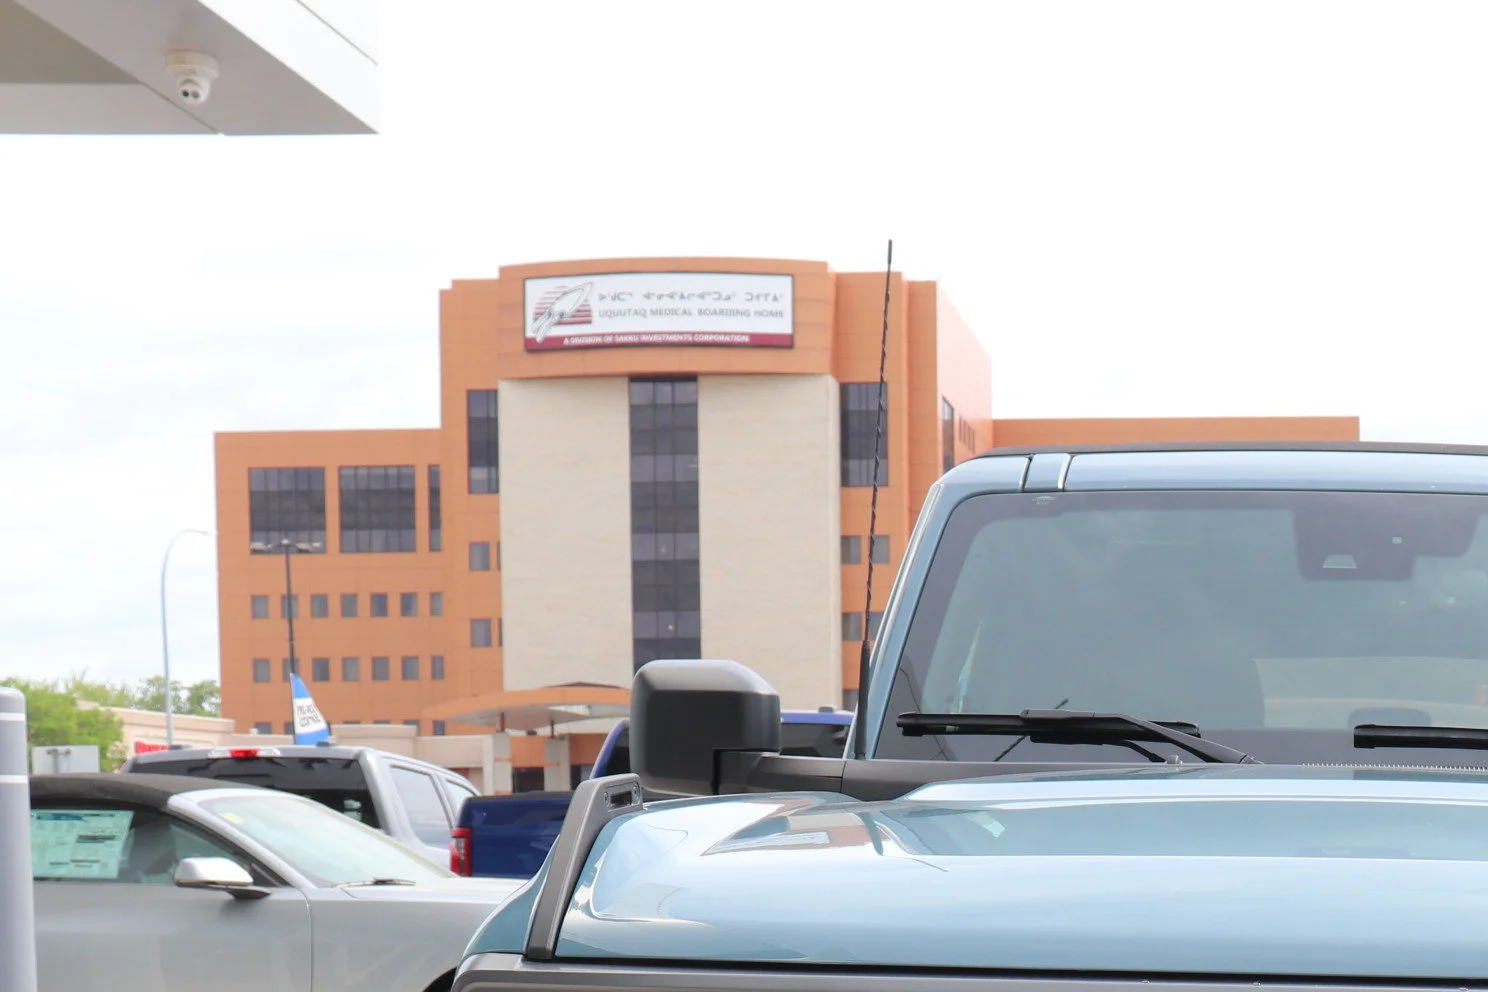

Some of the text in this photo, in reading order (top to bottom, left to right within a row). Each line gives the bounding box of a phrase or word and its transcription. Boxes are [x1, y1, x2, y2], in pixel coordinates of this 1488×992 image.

[650, 307, 692, 317] MEDICAL
[697, 307, 751, 317] BOARDING
[754, 308, 784, 318] HOME
[570, 335, 601, 344] DIVISION
[693, 334, 750, 343] CORPORATION
